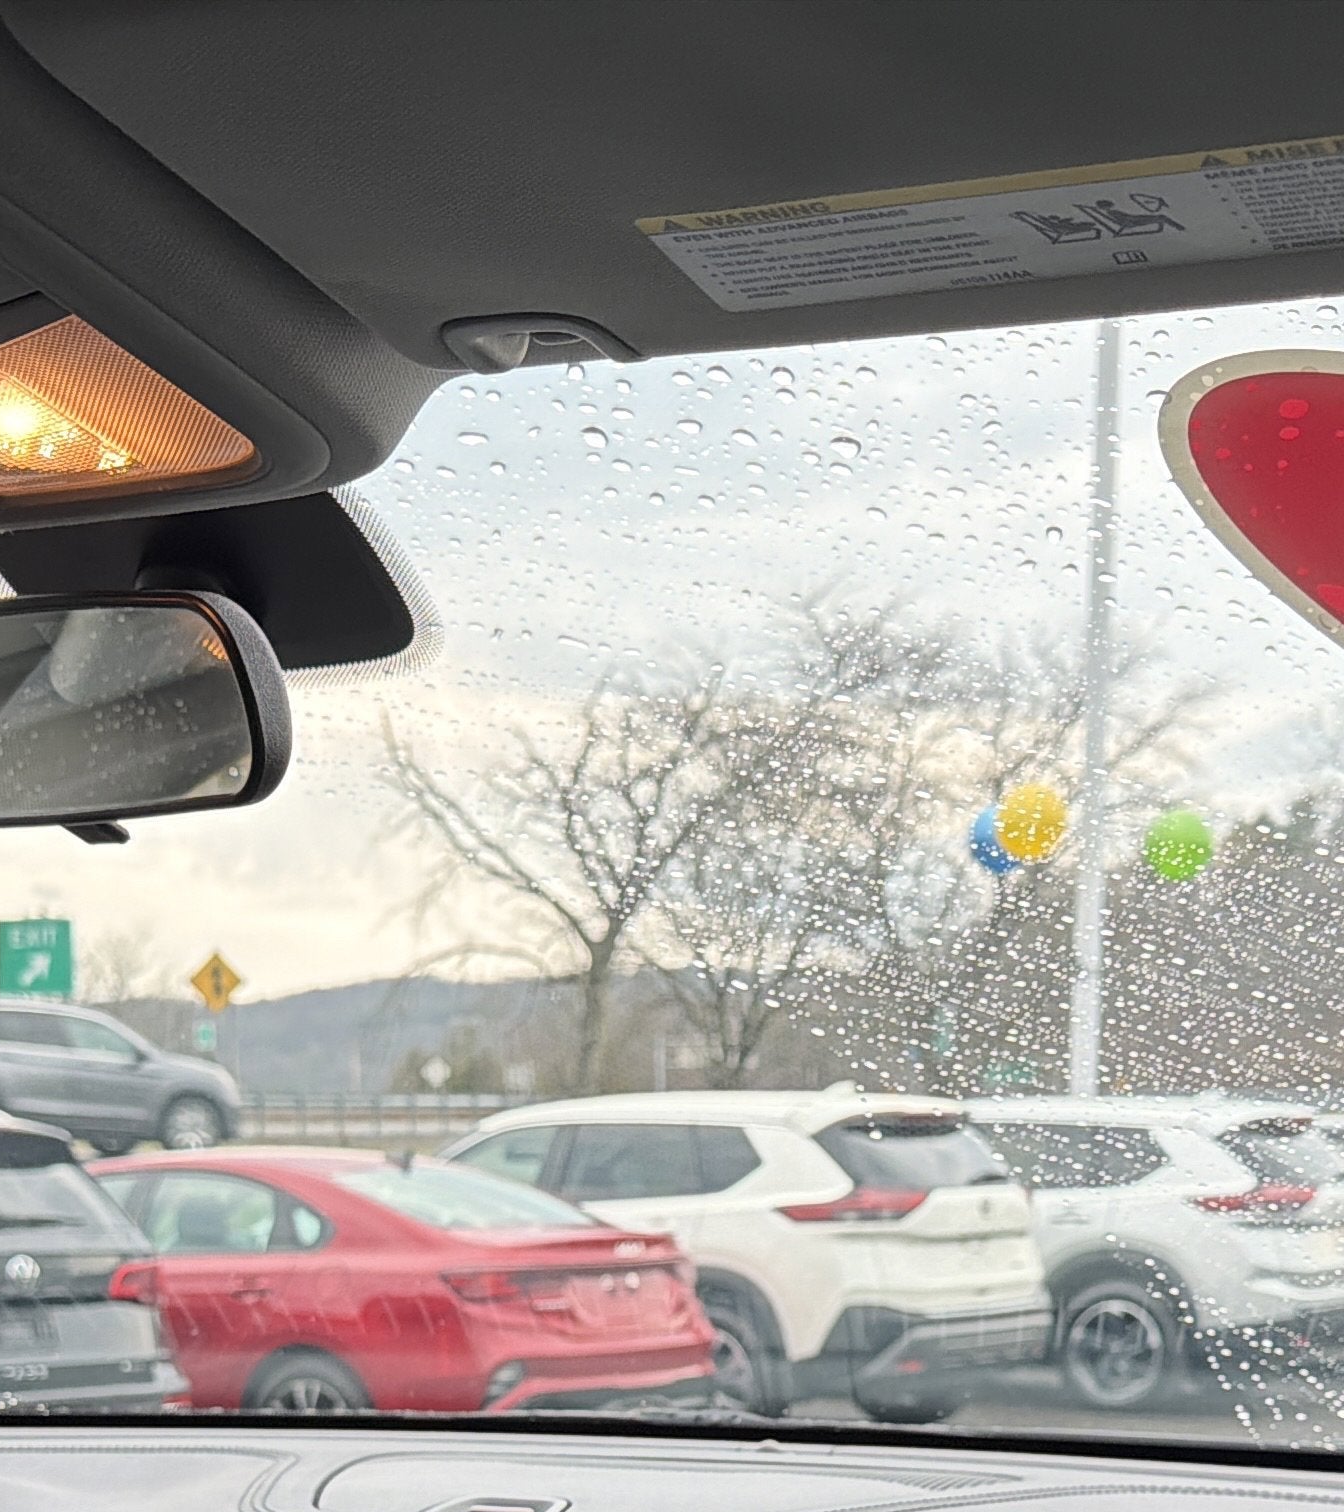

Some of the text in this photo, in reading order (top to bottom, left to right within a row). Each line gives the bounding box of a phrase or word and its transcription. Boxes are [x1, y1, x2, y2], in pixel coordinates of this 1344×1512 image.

[1247, 142, 1331, 162] MISE
[670, 208, 910, 243] EVEN WITH ADVANCED AIRBAGS
[695, 202, 833, 228] WARNING
